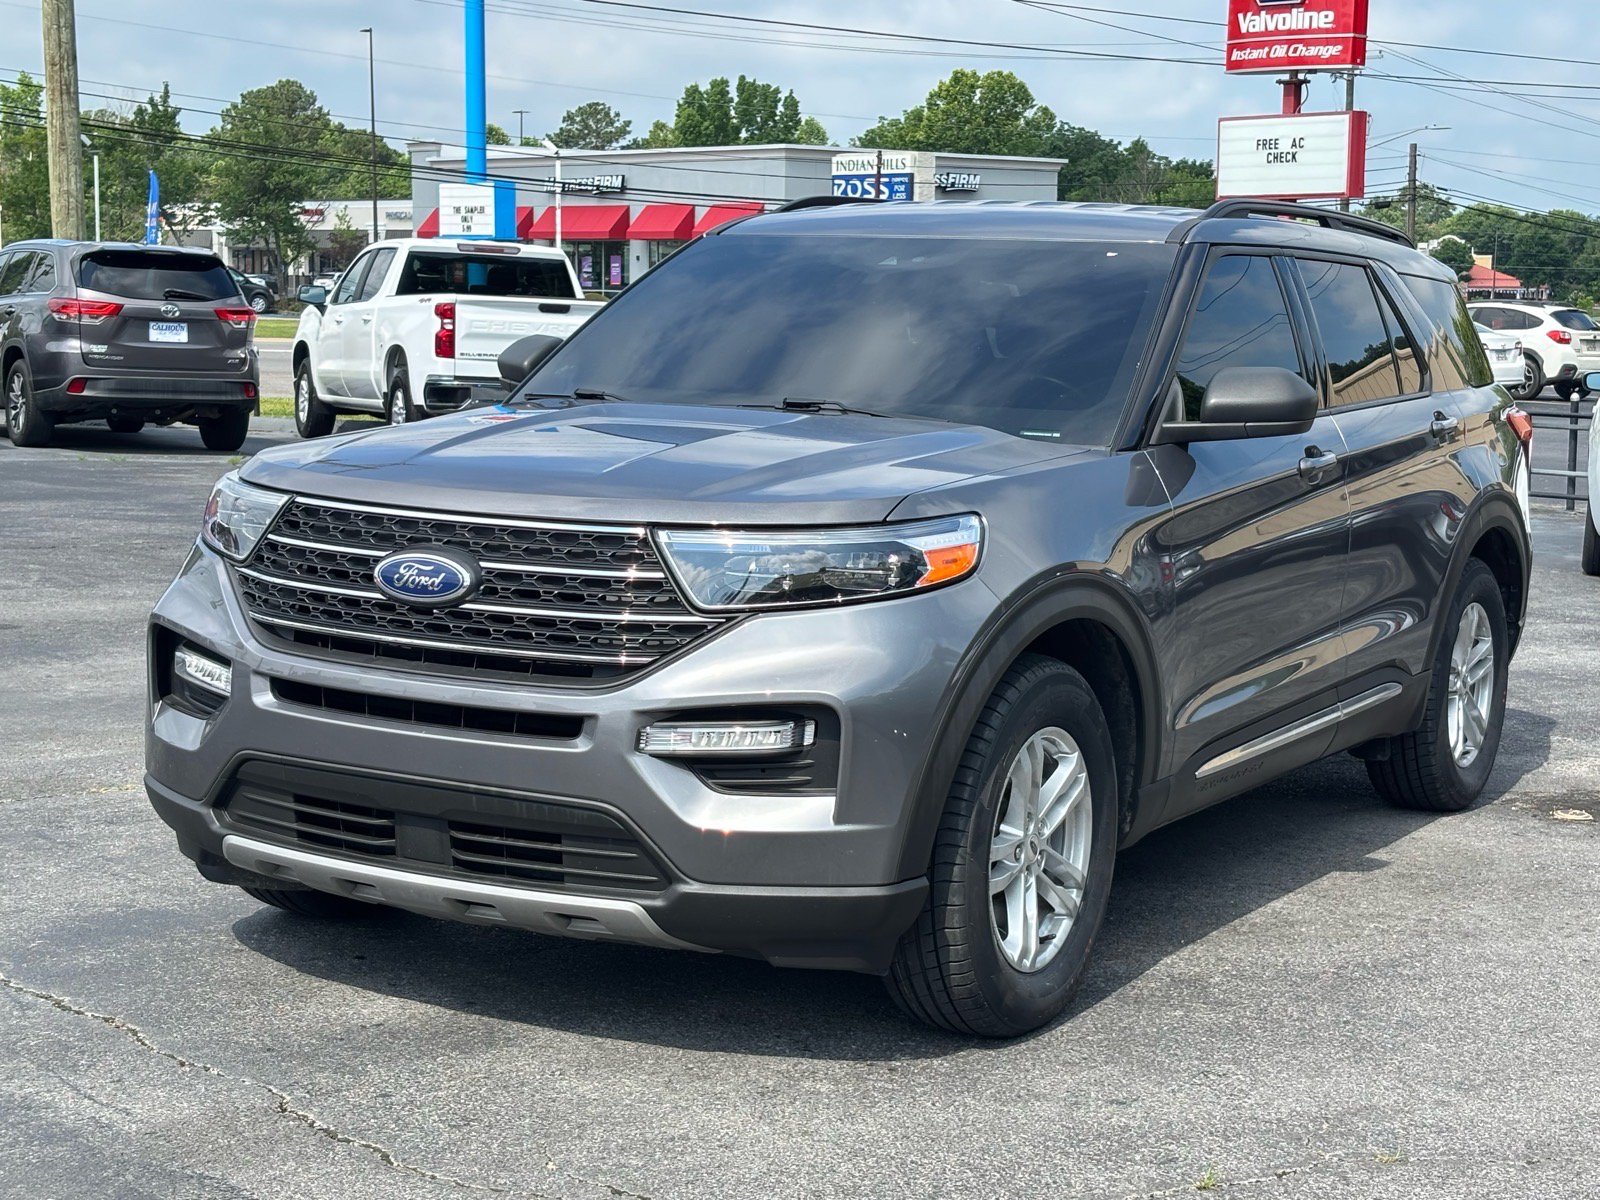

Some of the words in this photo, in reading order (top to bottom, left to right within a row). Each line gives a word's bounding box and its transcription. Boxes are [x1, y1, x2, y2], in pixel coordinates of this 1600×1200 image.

[1237, 8, 1334, 33] Valvoline
[1230, 46, 1269, 61] Instant
[1269, 44, 1287, 58] Oil
[1288, 43, 1343, 58] Change
[1256, 138, 1280, 151] FREE
[1290, 137, 1305, 149] AC
[836, 158, 874, 171] INDIAN
[1266, 151, 1297, 164] CHECK
[833, 178, 890, 199] ROSS
[151, 322, 186, 332] CALHOUN
[393, 562, 446, 591] Ford
